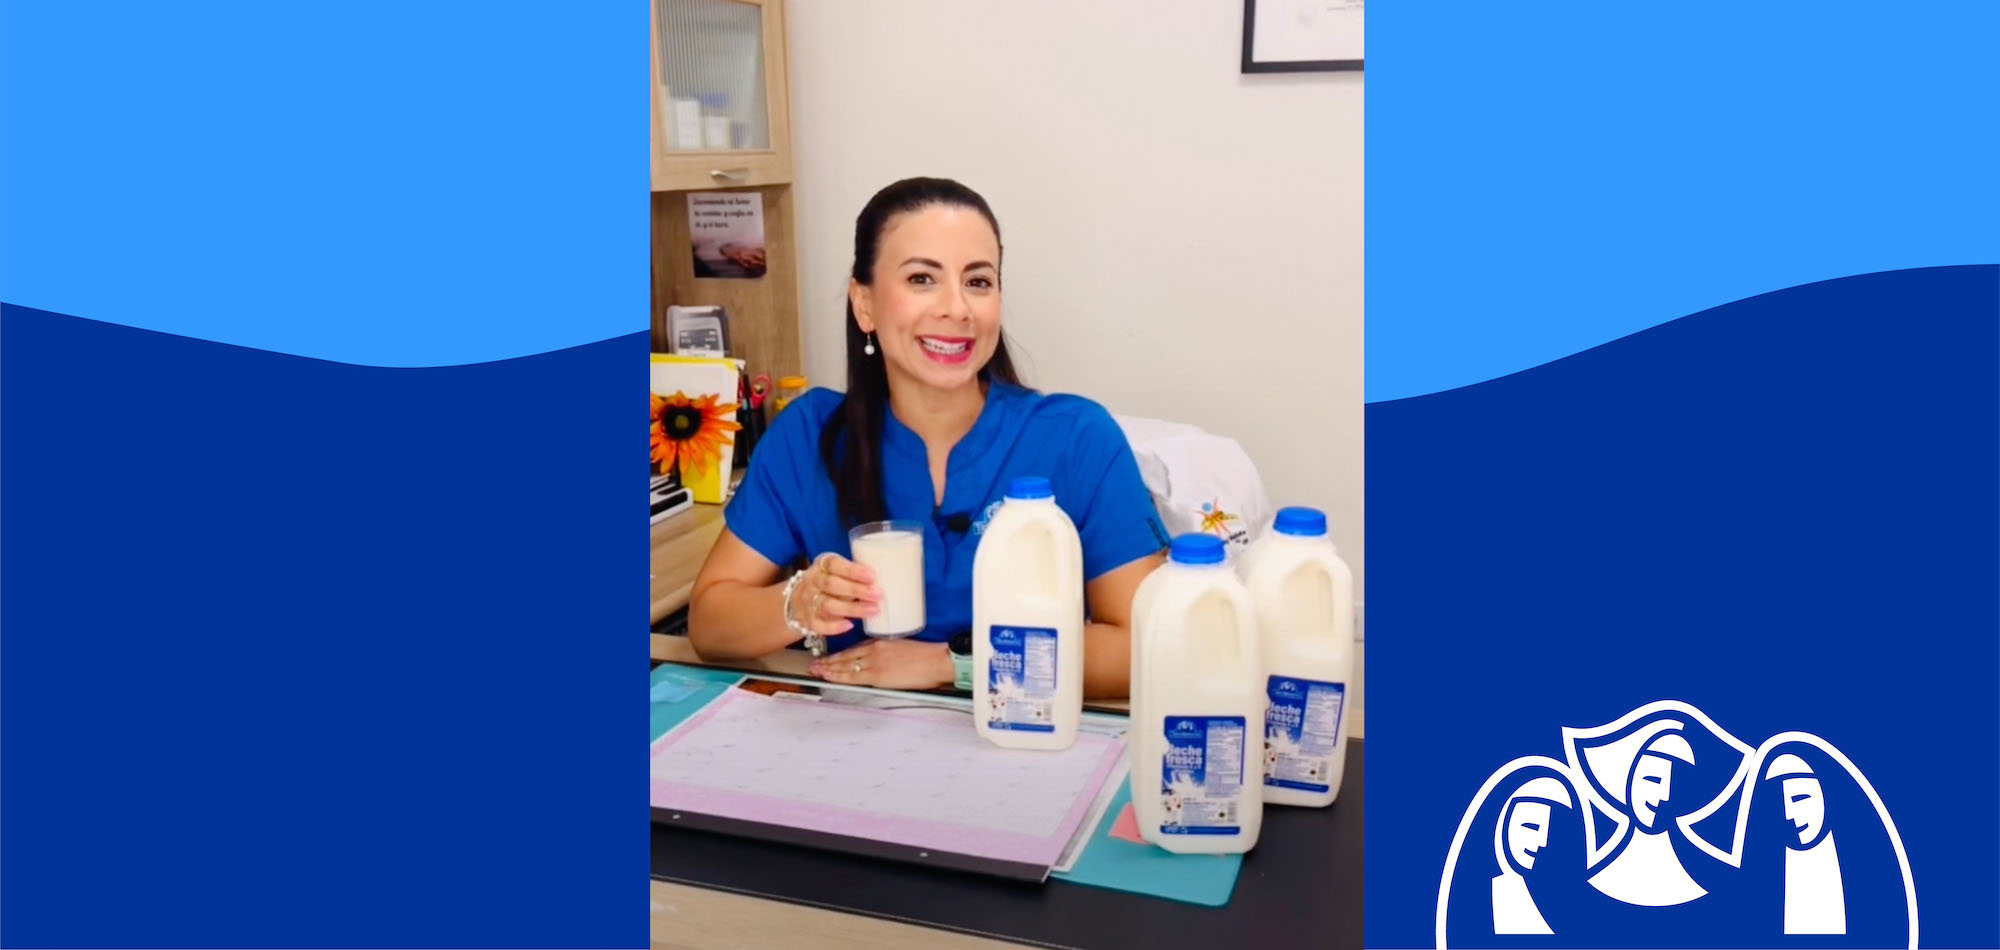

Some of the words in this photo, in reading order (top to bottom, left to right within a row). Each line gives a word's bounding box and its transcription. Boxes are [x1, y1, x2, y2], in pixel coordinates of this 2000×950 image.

[1271, 701, 1302, 716] leche
[1266, 709, 1301, 724] fresca
[1169, 743, 1203, 757] leche
[1166, 755, 1203, 765] fresca
